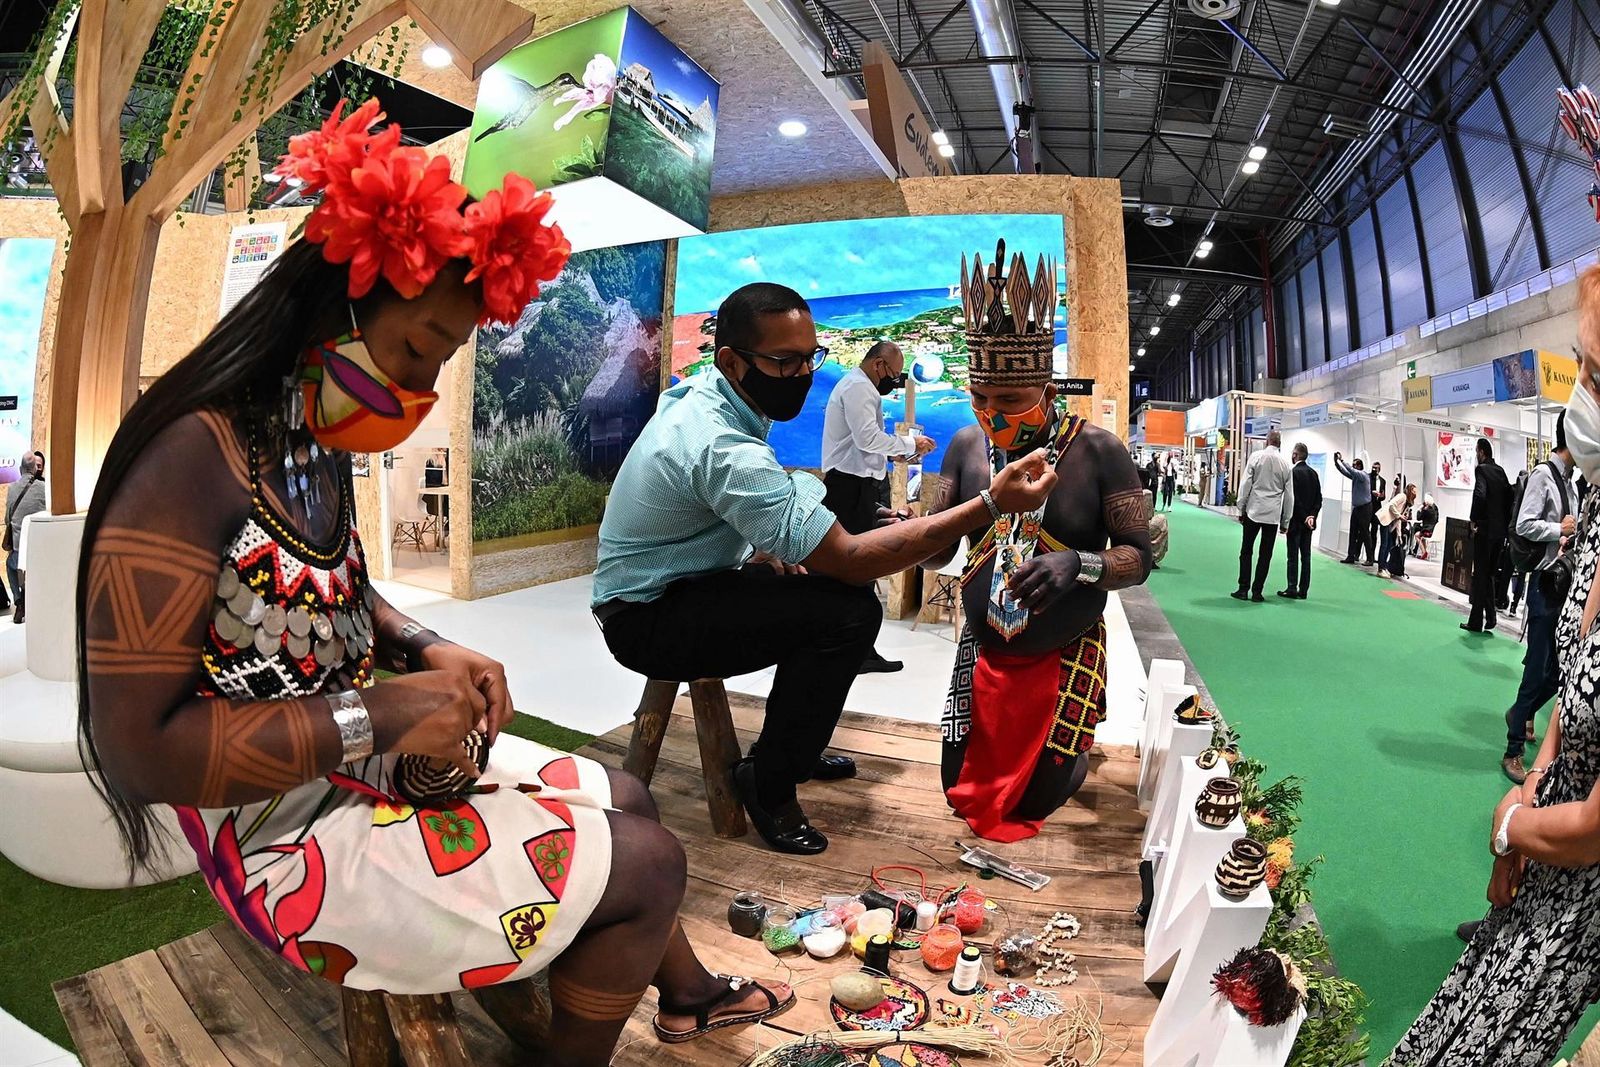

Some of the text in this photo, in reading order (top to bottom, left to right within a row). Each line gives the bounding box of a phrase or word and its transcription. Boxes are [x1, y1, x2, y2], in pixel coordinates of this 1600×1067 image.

[904, 112, 946, 177] Guatem
[1553, 371, 1577, 387] KANAN
[1066, 382, 1084, 390] Anita
[1416, 417, 1433, 425] REVISTA
